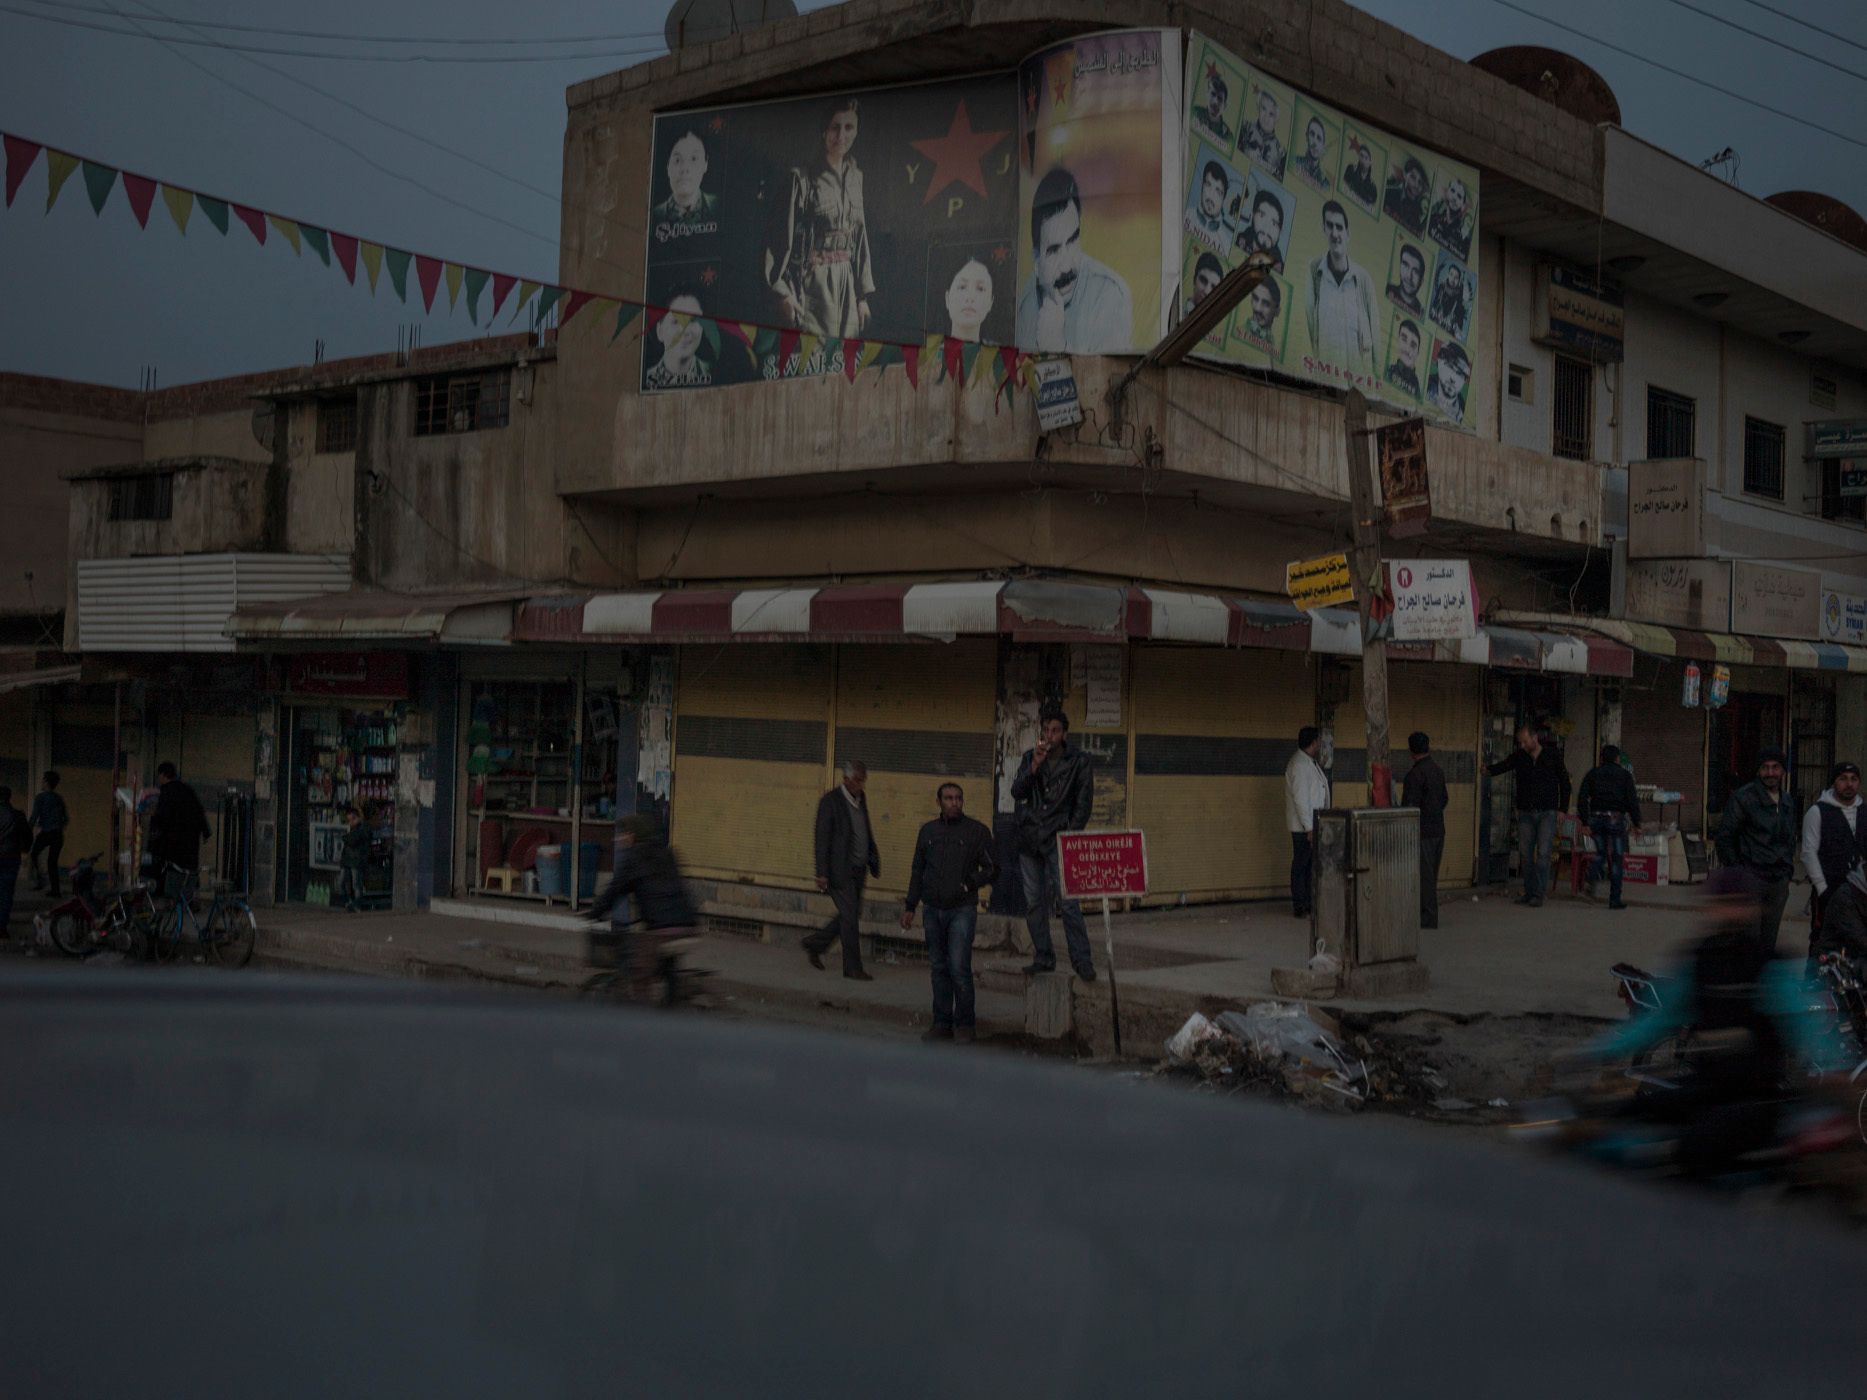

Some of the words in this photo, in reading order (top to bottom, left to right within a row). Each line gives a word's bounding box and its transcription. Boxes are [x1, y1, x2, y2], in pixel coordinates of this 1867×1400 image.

[996, 152, 1010, 176] J
[906, 163, 921, 185] Y
[947, 197, 964, 219] P
[1633, 500, 1654, 514] الجراح
[1655, 500, 1669, 514] صالح
[1670, 497, 1688, 512] فرحان
[1426, 567, 1455, 582] الدكتور
[1397, 593, 1421, 611] الجراح
[1422, 592, 1442, 611] صالح
[1443, 590, 1465, 610] فرحان
[1117, 864, 1140, 878] ممنوع
[1079, 877, 1105, 890] المكان
[1106, 878, 1120, 889] هذا
